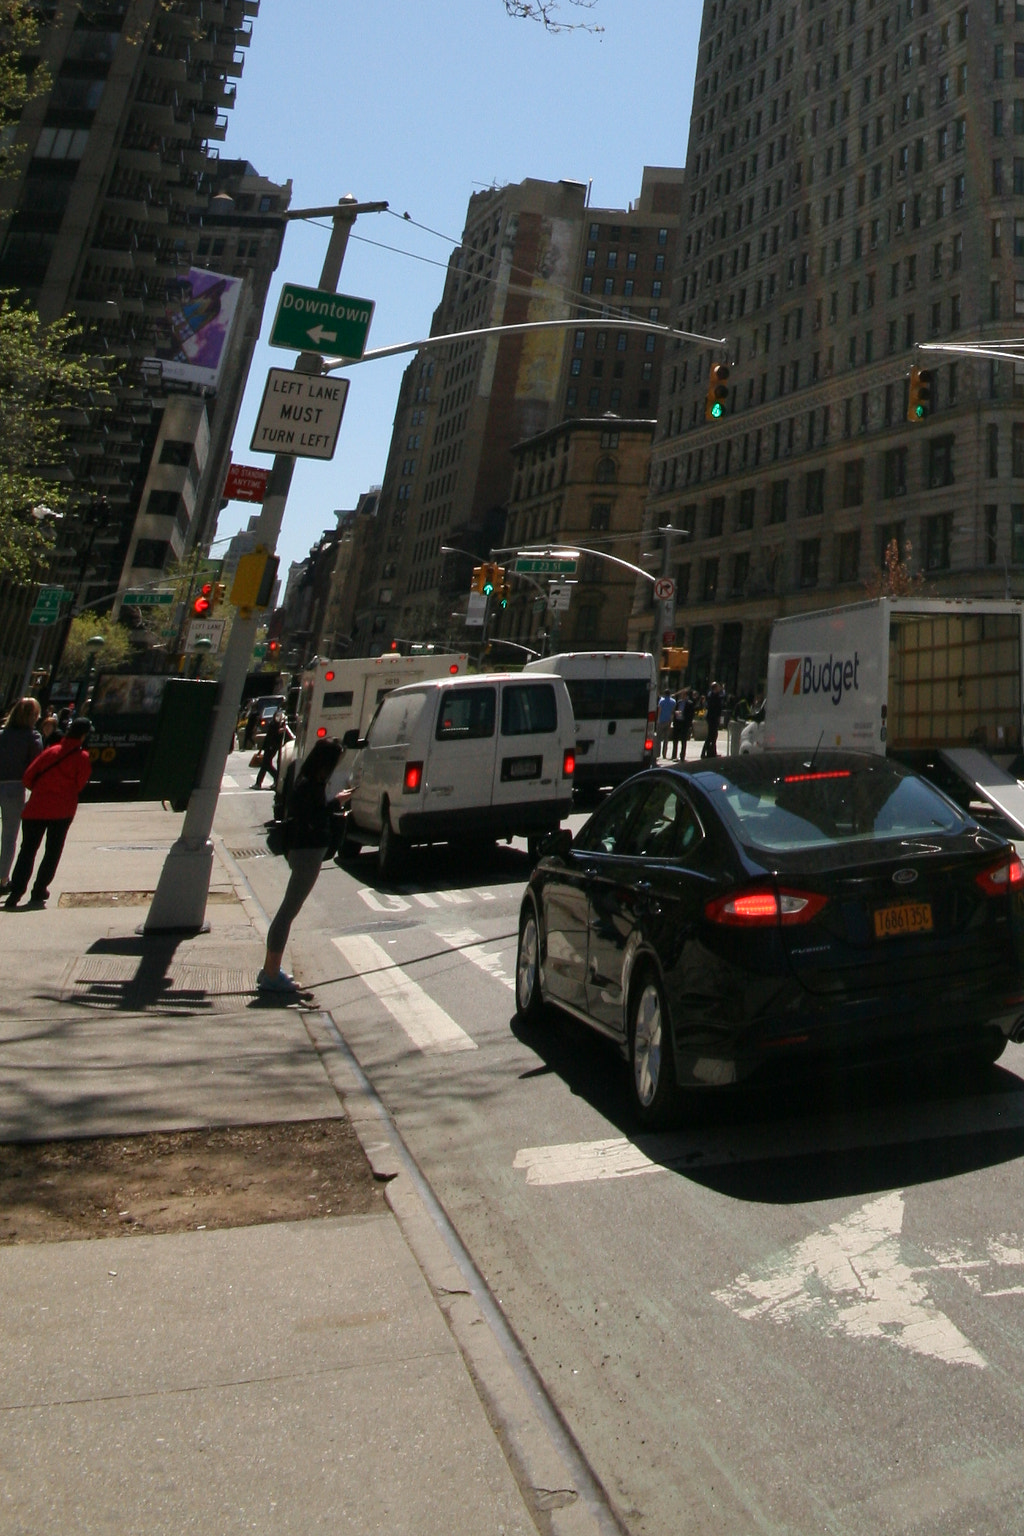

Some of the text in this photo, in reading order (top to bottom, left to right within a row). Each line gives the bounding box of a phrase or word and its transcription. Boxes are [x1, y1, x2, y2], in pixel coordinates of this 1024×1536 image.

[283, 293, 370, 323] Downtown
[273, 380, 340, 401] LEFT LANE
[280, 404, 323, 423] MUST
[262, 427, 331, 448] TURN LEFT
[233, 478, 261, 488] ANYTIME
[531, 562, 537, 571] E
[540, 562, 549, 571] 23
[803, 651, 860, 705] Budget
